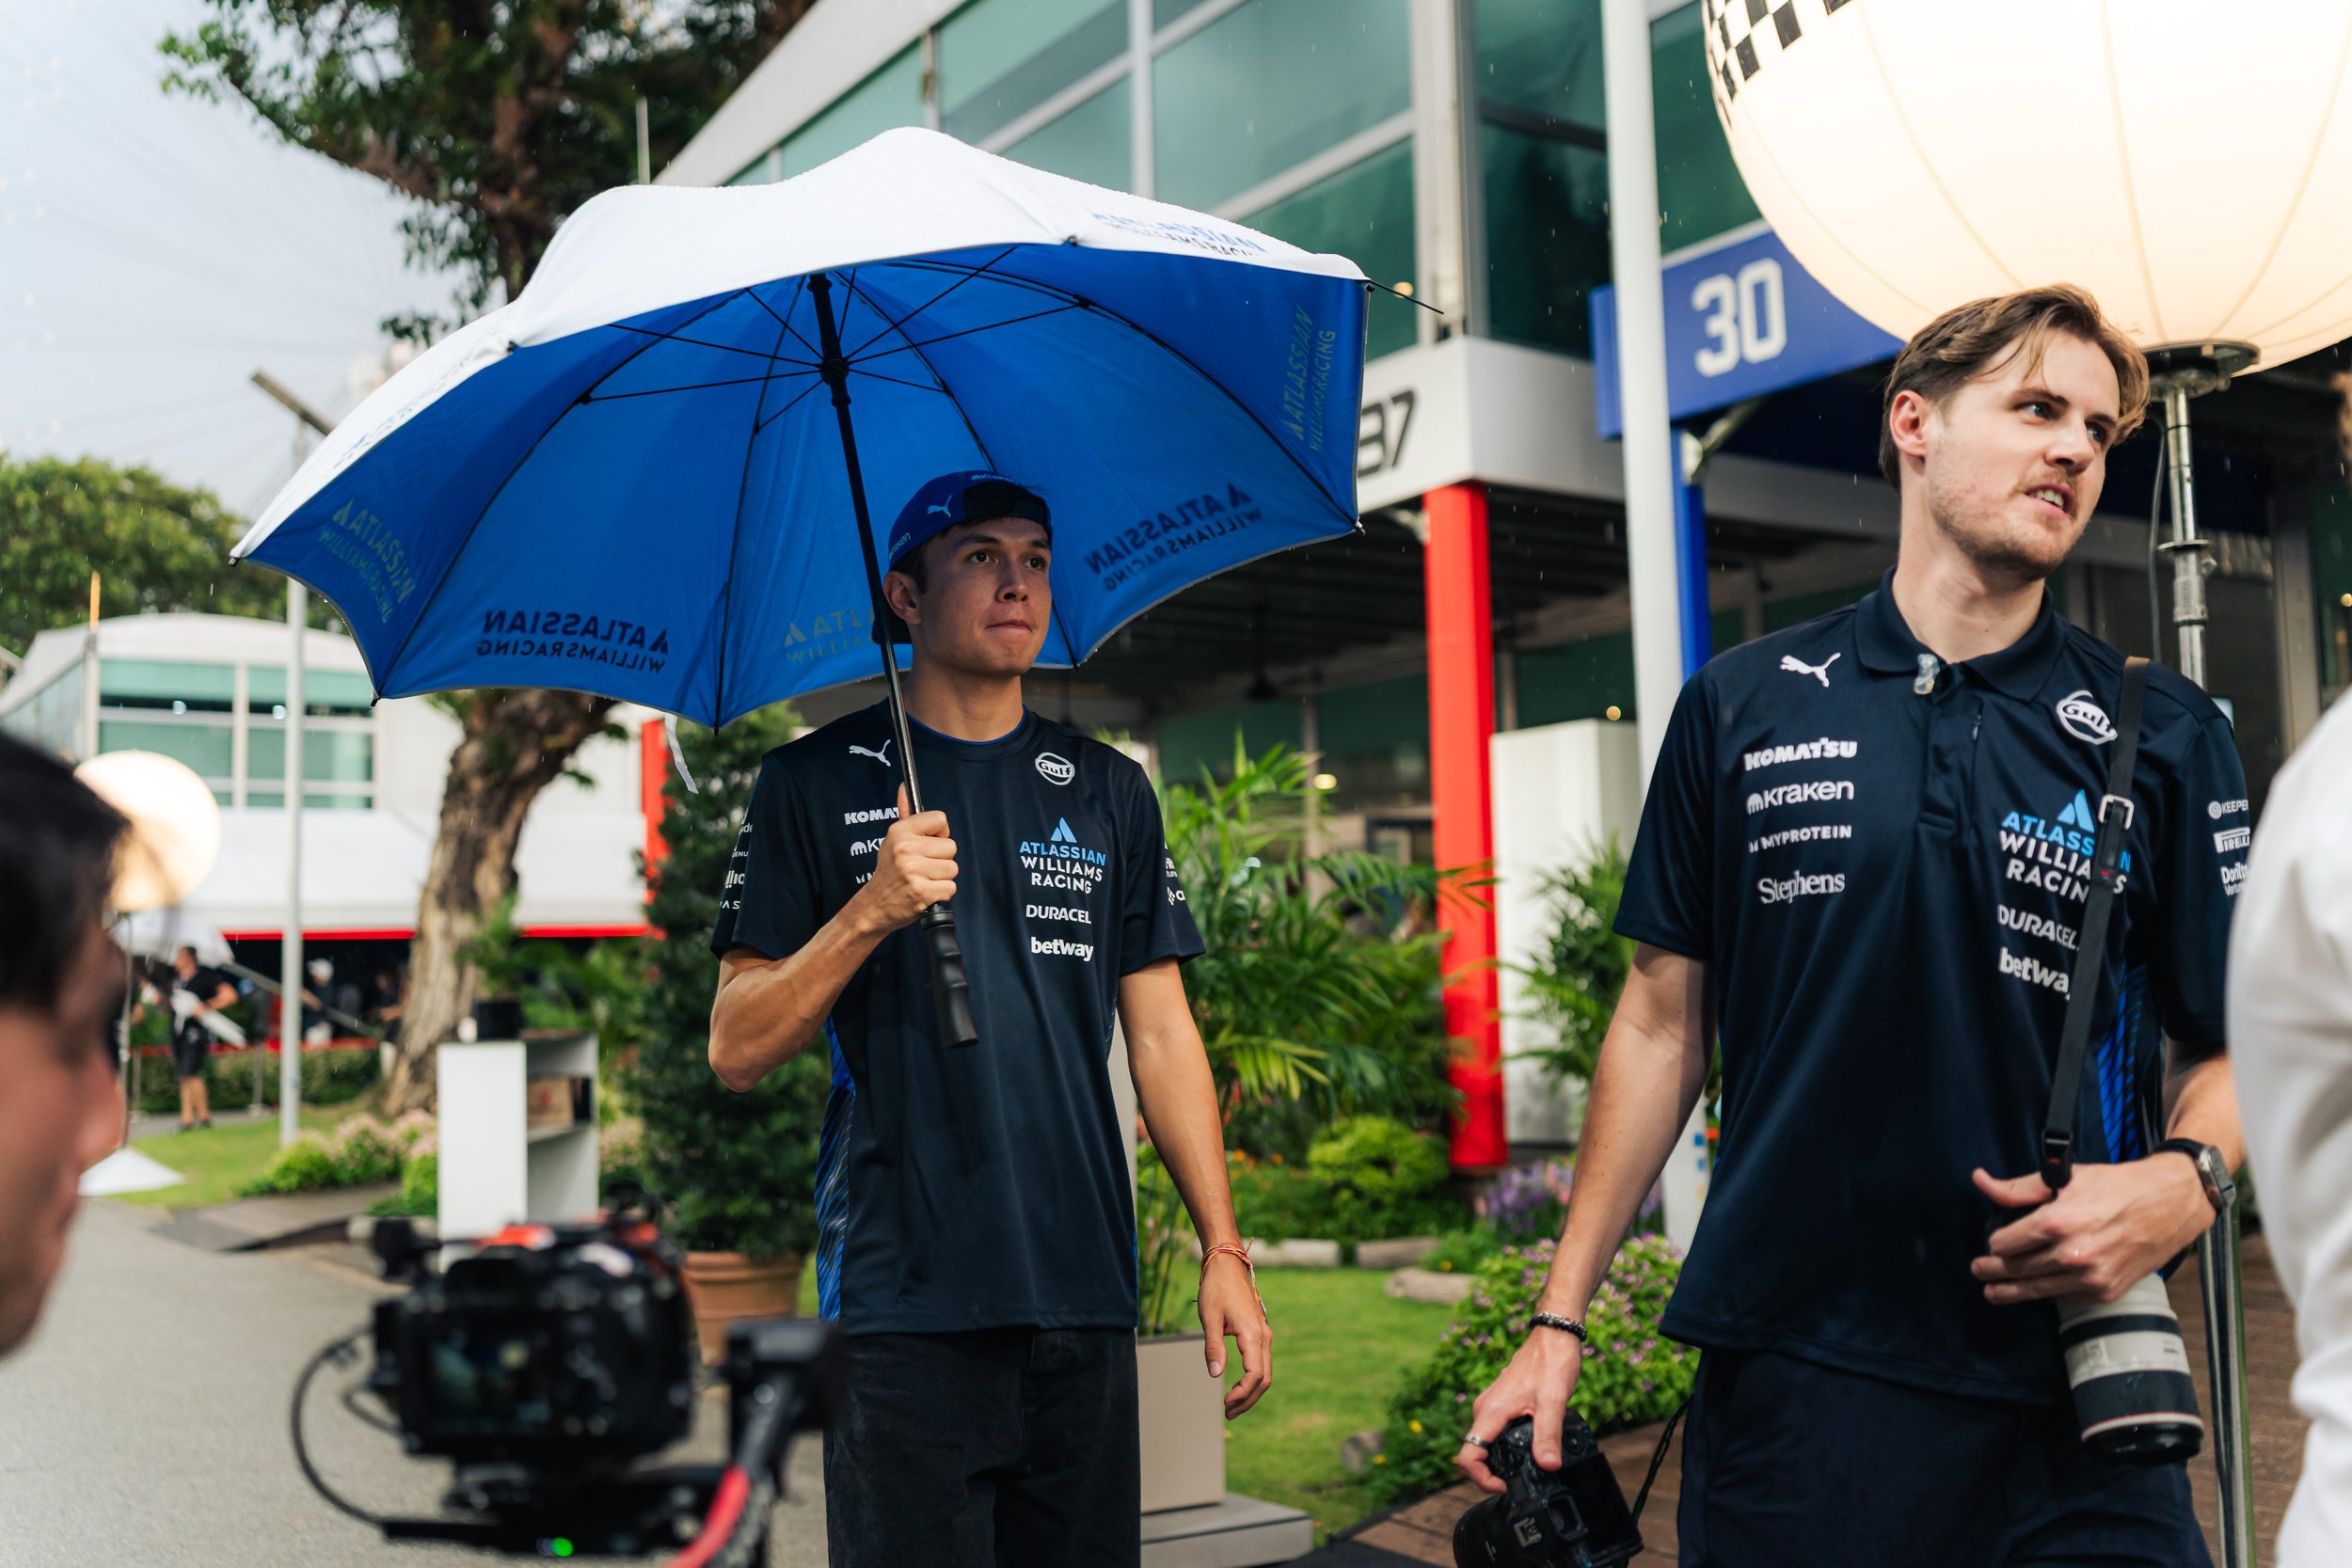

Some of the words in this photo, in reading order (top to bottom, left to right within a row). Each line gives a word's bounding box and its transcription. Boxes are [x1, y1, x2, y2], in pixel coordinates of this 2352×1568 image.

[1692, 257, 1787, 377] 30
[1743, 737, 1858, 771] KOMATSU
[844, 807, 899, 825] KOMAT
[1019, 841, 1106, 866] ATLASSIAN
[1761, 825, 1852, 850] MYPROTEIN
[2001, 811, 2131, 873] ATLASSN
[1021, 856, 1103, 882] WILLIAMS
[1999, 830, 2127, 894] WILLIAS
[1031, 872, 1092, 894] RACING
[1757, 870, 1846, 904] Stephens
[2006, 858, 2090, 904] RACIN
[1998, 904, 2078, 951] DURACEL
[1030, 936, 1094, 961] betway
[1999, 946, 2070, 1001] betwa
